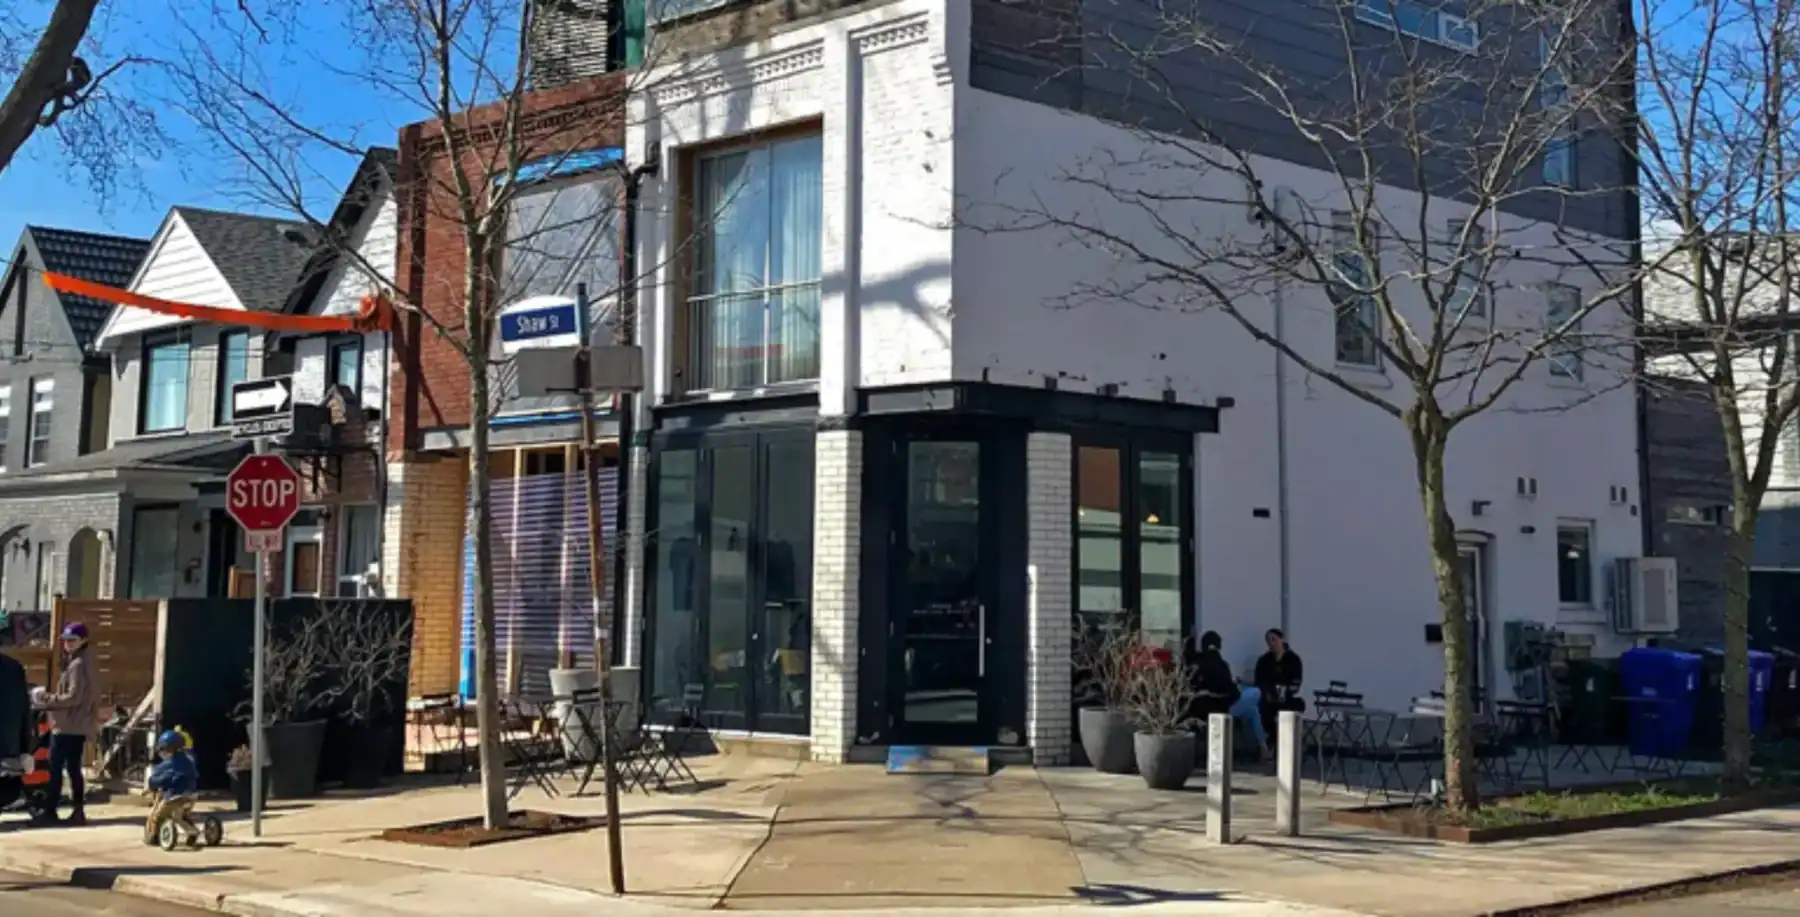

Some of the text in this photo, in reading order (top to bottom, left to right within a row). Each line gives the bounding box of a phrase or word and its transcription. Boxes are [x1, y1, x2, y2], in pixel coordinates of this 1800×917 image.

[516, 314, 560, 335] Shaw St
[232, 478, 295, 508] STOP
